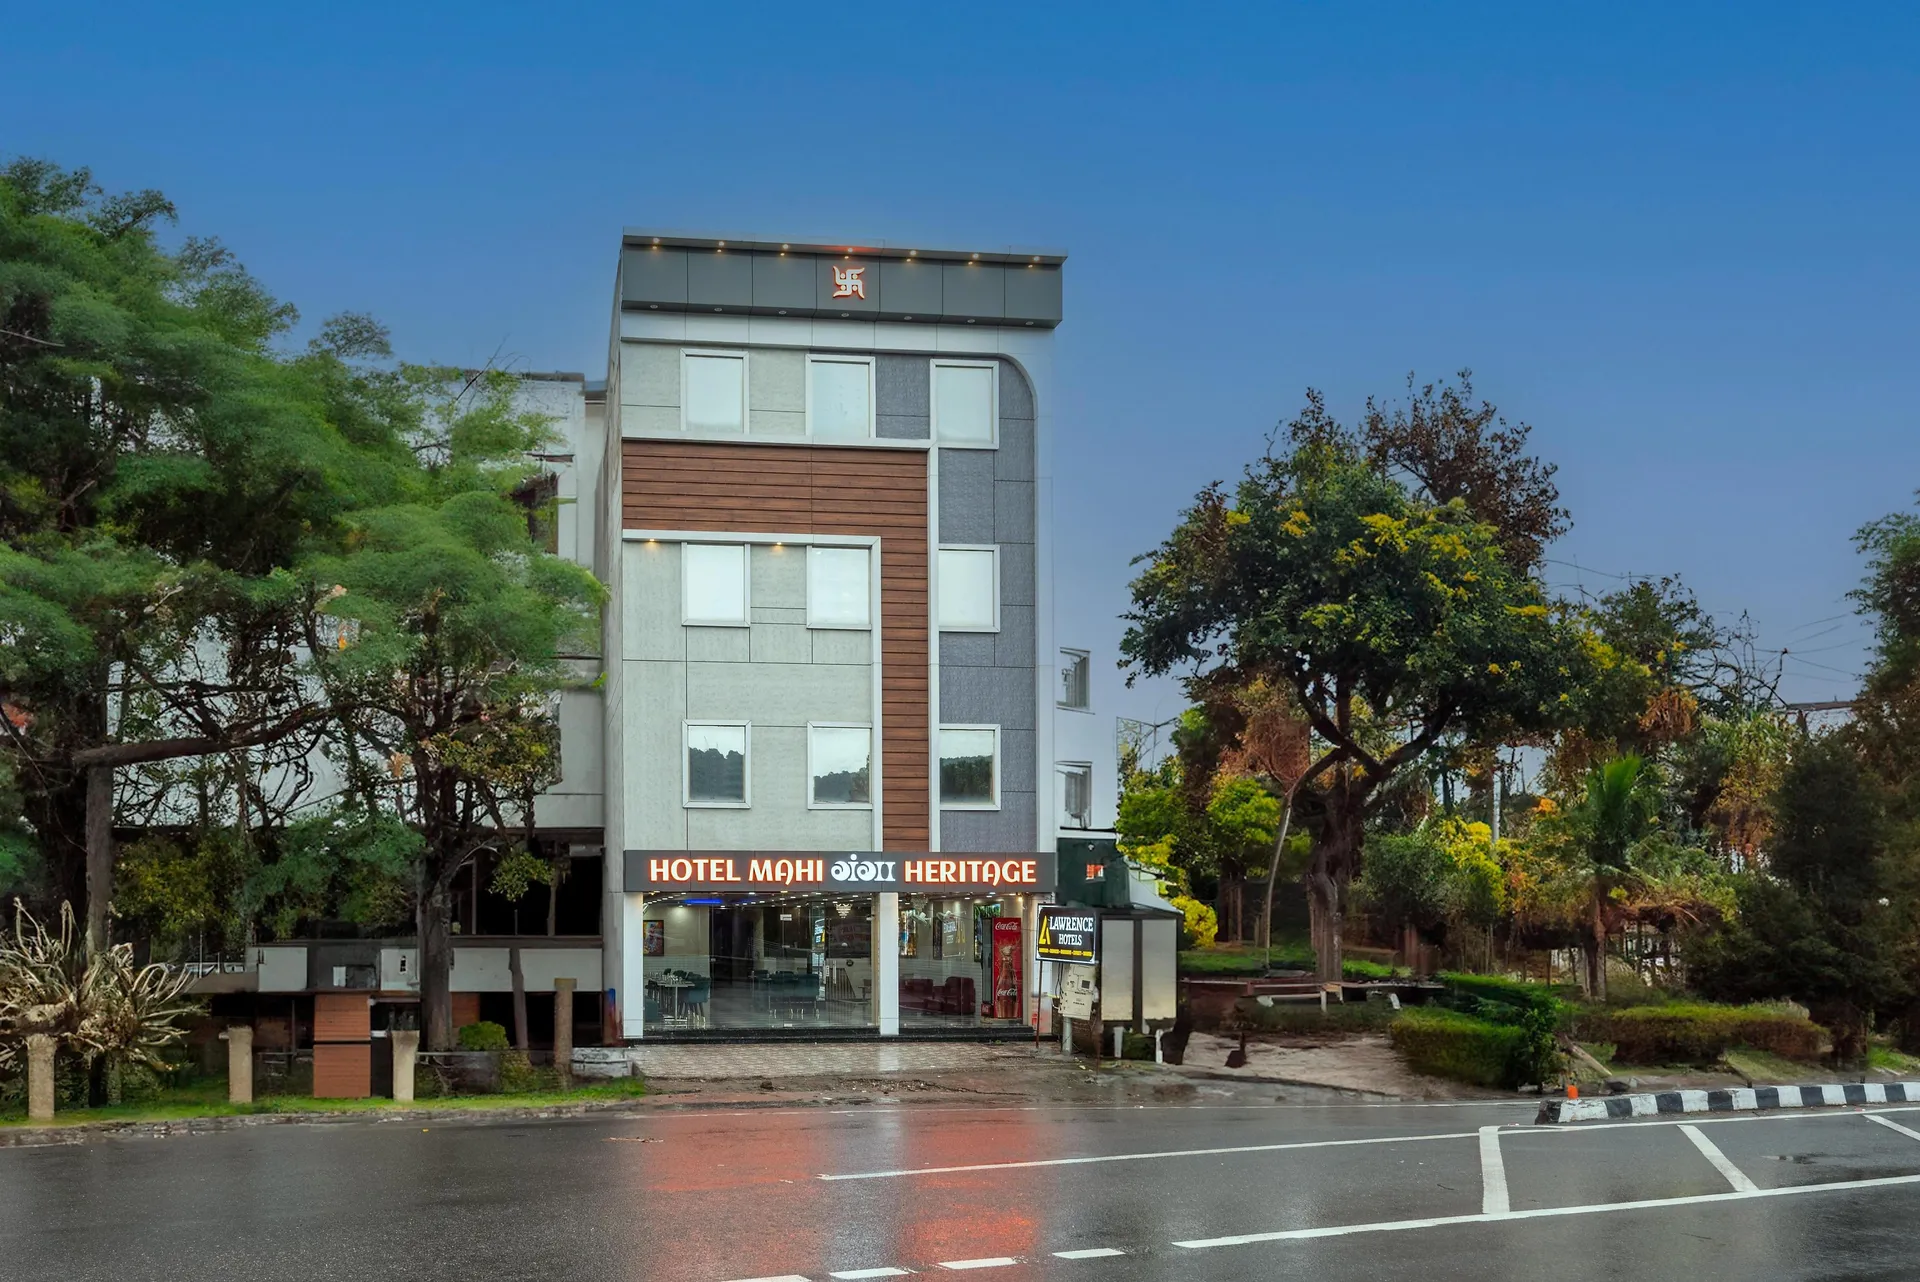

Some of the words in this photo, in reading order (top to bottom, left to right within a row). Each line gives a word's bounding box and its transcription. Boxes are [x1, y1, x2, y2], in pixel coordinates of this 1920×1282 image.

[650, 858, 742, 882] HOTEL
[748, 858, 824, 886] MAHI
[904, 859, 1037, 887] HERITAGE
[1049, 916, 1094, 932] LAWRENCE
[1058, 933, 1083, 946] HOTELS
